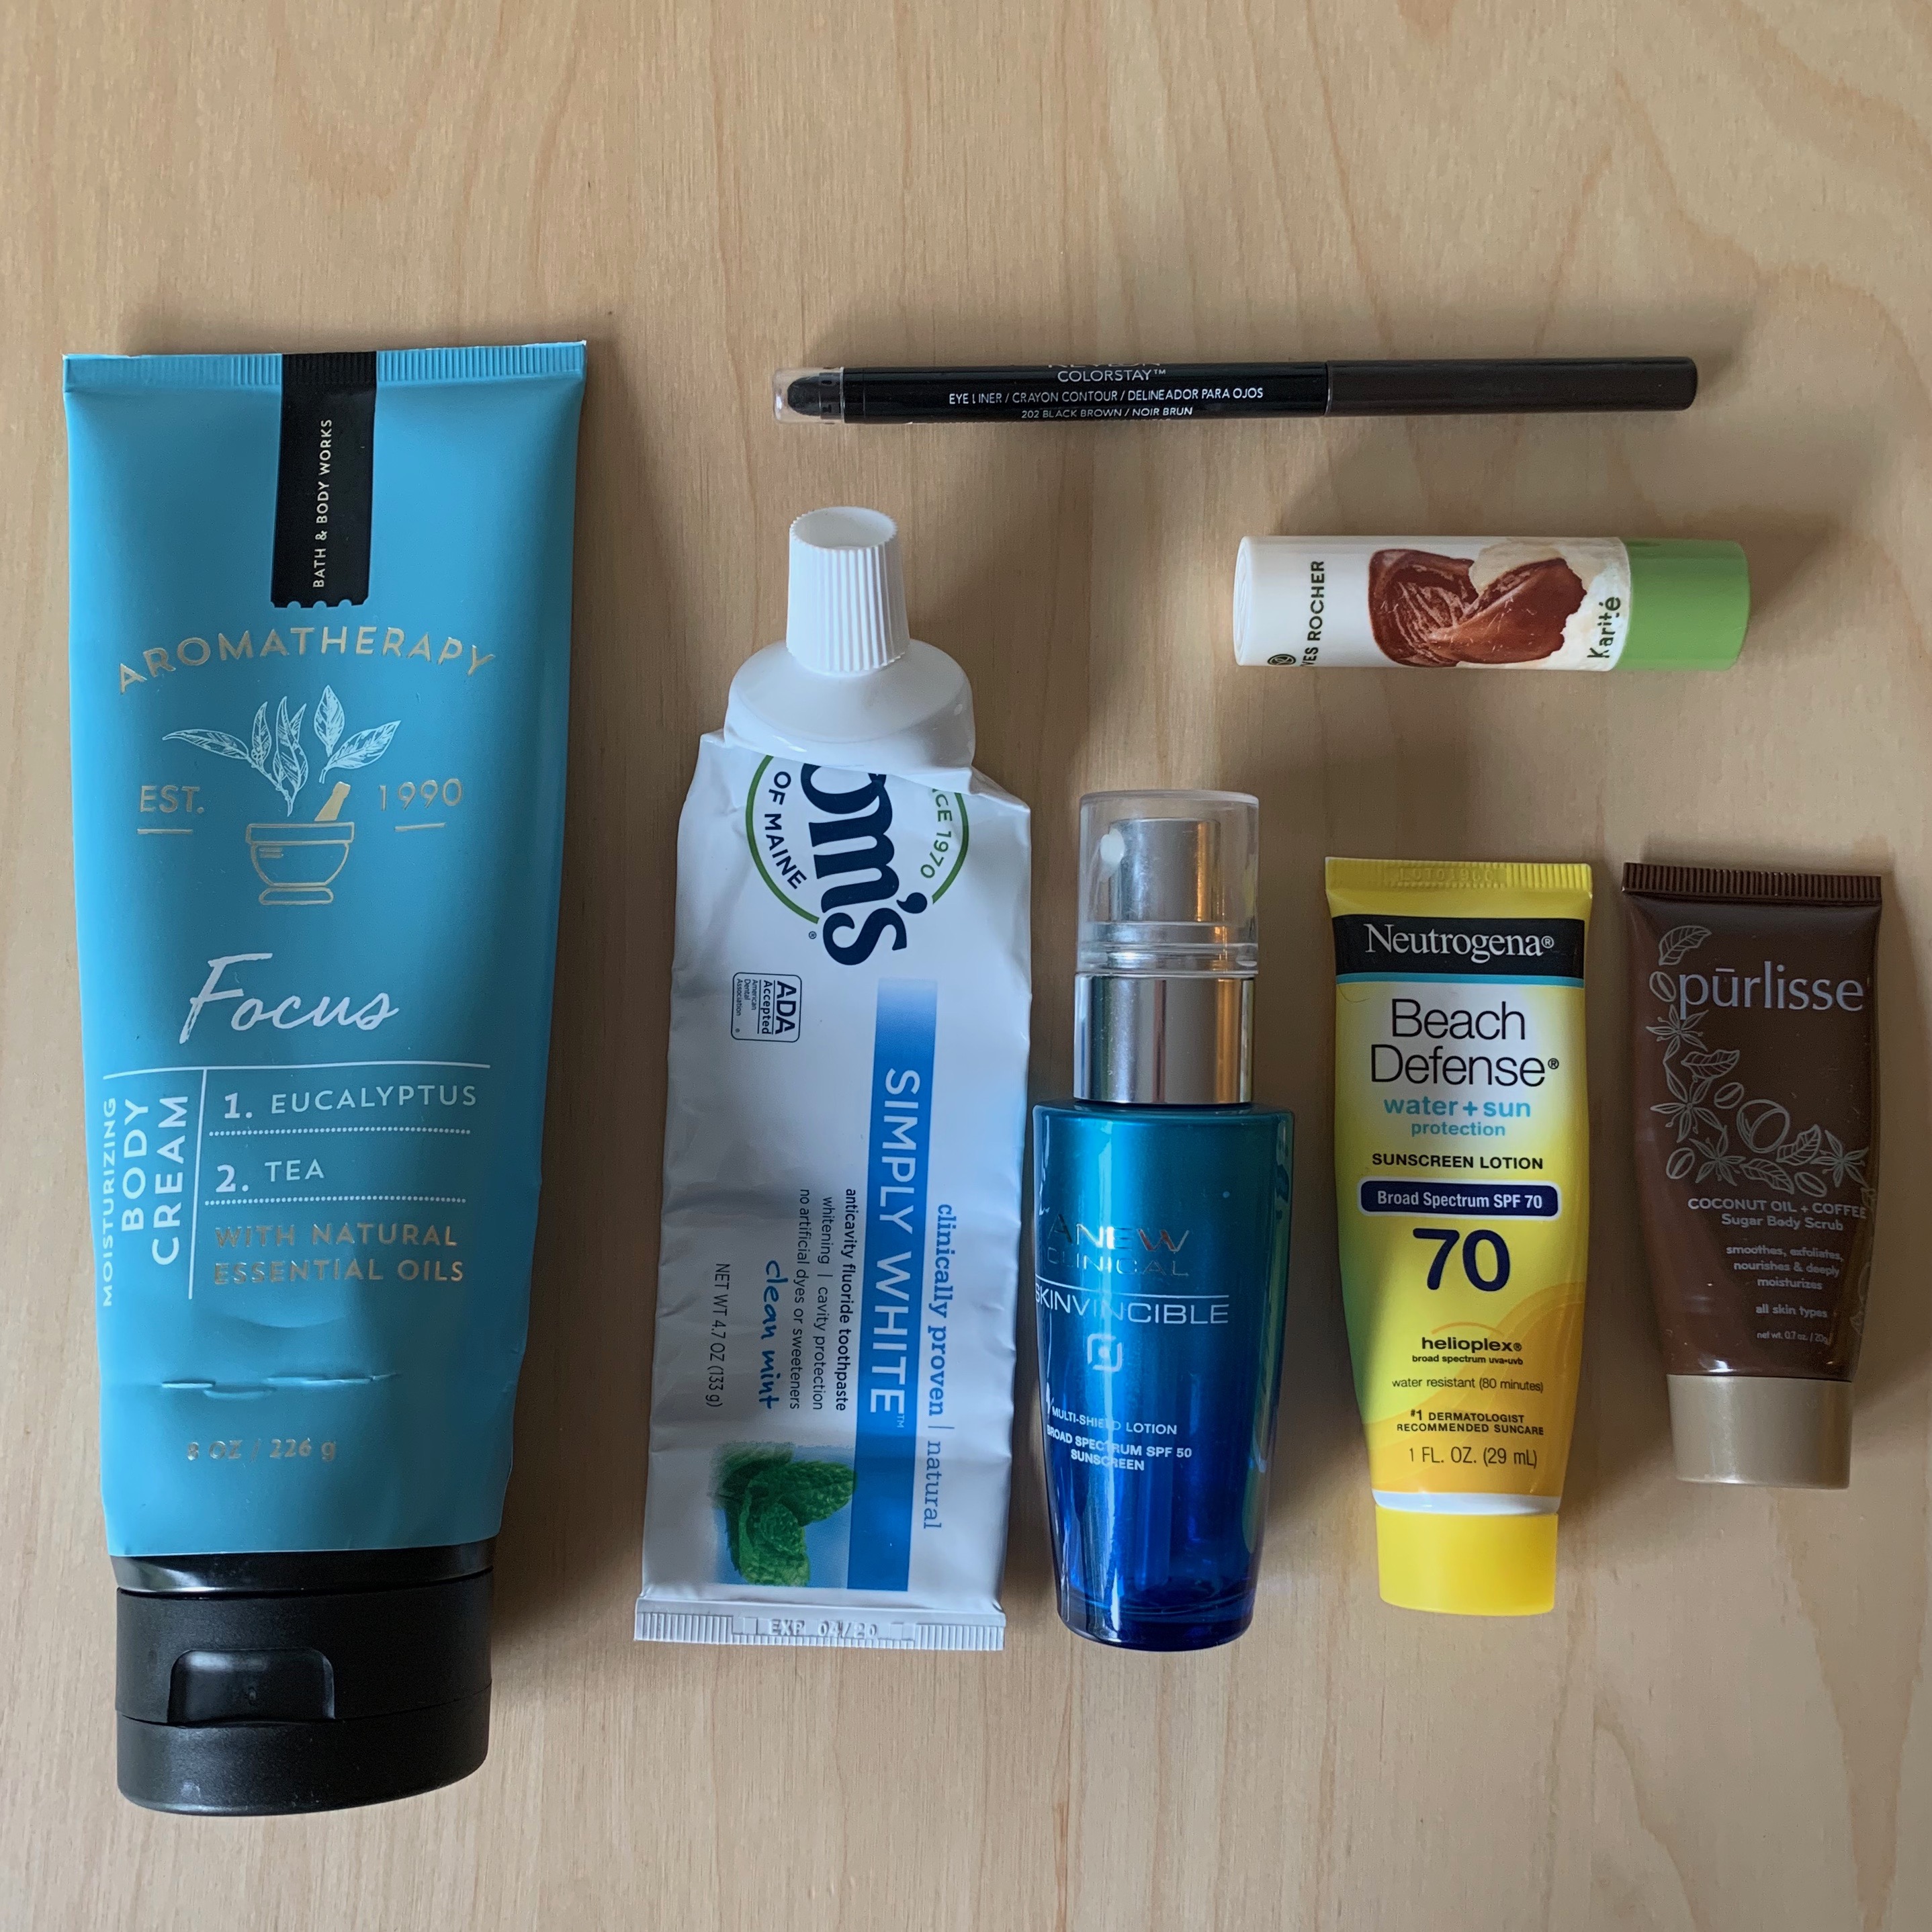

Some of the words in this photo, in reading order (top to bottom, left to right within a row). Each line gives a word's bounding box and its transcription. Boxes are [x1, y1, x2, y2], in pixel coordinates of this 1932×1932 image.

[949, 393, 969, 404] EYE
[972, 392, 1002, 404] LINER
[1012, 392, 1059, 403] CRAYON
[1062, 390, 1118, 402] CONTOUR
[1128, 388, 1198, 401] DELINEADOR
[1201, 388, 1230, 400] PARA
[1233, 388, 1264, 399] OJOS
[1021, 410, 1040, 419] 202
[1043, 409, 1078, 419] BLACK
[1080, 408, 1122, 417] BROWN
[1132, 408, 1159, 416] NOIR
[1163, 406, 1193, 416] BRUN
[318, 419, 333, 475] WORKS
[316, 480, 330, 524] BODY
[316, 527, 328, 541] &
[312, 549, 326, 588] BATH
[1307, 561, 1325, 641] ROCHER
[120, 627, 496, 694] AROMATHERAPY
[140, 785, 204, 814] EST.
[380, 778, 463, 811] 1990
[769, 771, 791, 806] OF
[932, 789, 953, 822] CE
[764, 814, 807, 889] MAINE
[920, 831, 952, 879] 1970
[179, 953, 399, 1044] Focus
[760, 980, 773, 1035] Accepted
[775, 981, 797, 1035] ADA
[1392, 998, 1525, 1041] Beach
[224, 1092, 253, 1120] 1.
[271, 1085, 477, 1115] EUCALYPTUS
[1384, 1096, 1458, 1116] water
[1483, 1101, 1531, 1117] sun
[1411, 1121, 1505, 1137] protection
[122, 1098, 148, 1231] BODY
[879, 1069, 920, 1235] SIMPLY
[1372, 1153, 1474, 1168] SUNSCREEN
[1480, 1155, 1543, 1170] LOTION
[152, 1096, 188, 1265] CREAM
[216, 1164, 249, 1194] 2.
[265, 1159, 325, 1182] TEA
[103, 1098, 116, 1307] MOISTURIZING
[799, 1188, 809, 1204] no
[1377, 1190, 1419, 1206] Broad
[1423, 1192, 1489, 1209] Spectrum
[1493, 1194, 1521, 1209] SPF
[1524, 1195, 1542, 1209] 70
[1687, 1198, 1767, 1211] COCONUT
[1771, 1201, 1797, 1213] OIL
[1812, 1202, 1867, 1219] COFFEE
[215, 1225, 296, 1248] WITH
[312, 1223, 458, 1247] NATURAL
[797, 1207, 811, 1264] artificial
[818, 1196, 835, 1264] whitening
[841, 1188, 858, 1258] anticavity
[1047, 1213, 1190, 1252] ANEW
[1722, 1213, 1763, 1227] Sugar
[1767, 1215, 1800, 1230] Body
[1804, 1217, 1843, 1231] Scrub
[214, 1260, 383, 1284] ESSENTIAL
[398, 1259, 464, 1282] OILS
[715, 1264, 730, 1290] NET
[929, 1202, 956, 1319] clinically
[1047, 1247, 1189, 1276] CLINICAL
[1413, 1228, 1511, 1292] 70
[1734, 1260, 1790, 1272] nourishes
[1806, 1264, 1839, 1277] deeply
[760, 1260, 788, 1340] clean
[793, 1270, 809, 1303] dyes
[840, 1264, 856, 1323] fluoride
[1757, 1276, 1823, 1290] moisturizes
[713, 1294, 728, 1316] WT
[793, 1309, 804, 1325] or
[814, 1286, 830, 1331] cavity
[1035, 1282, 1229, 1324] SKINVINCIBLE
[1755, 1304, 1768, 1314] all
[1772, 1305, 1796, 1315] skin
[1799, 1306, 1828, 1318] types
[711, 1319, 726, 1339] 4.7
[709, 1344, 725, 1361] OZ
[790, 1329, 803, 1409] sweeteners
[834, 1329, 851, 1411] toothpaste
[928, 1325, 949, 1415] proven
[1412, 1355, 1440, 1363] broad
[1442, 1356, 1487, 1365] spectrum
[707, 1366, 723, 1391] (133
[758, 1350, 780, 1409] mint
[812, 1335, 827, 1410] protection
[1392, 1378, 1421, 1388] water
[1427, 1376, 1475, 1388] resistant
[1479, 1377, 1497, 1391] (80
[1500, 1379, 1544, 1393] minutes)
[1126, 1422, 1177, 1435] LOTION
[1397, 1423, 1489, 1432] RECOMMENDED
[1494, 1424, 1544, 1436] SUNCARE
[1411, 1409, 1422, 1421] #1
[1429, 1412, 1524, 1423] DERMATOLOGIST
[187, 1442, 200, 1461] 8
[208, 1440, 243, 1460] OZ
[269, 1438, 312, 1459] 226
[320, 1442, 336, 1462] g
[1047, 1424, 1073, 1444] BROAD
[1146, 1446, 1172, 1458] SPF
[1176, 1448, 1192, 1458] 50
[1409, 1448, 1414, 1462] 1
[1422, 1447, 1444, 1463] FL.
[1451, 1446, 1477, 1464] OZ.
[1483, 1447, 1507, 1467] (29
[1513, 1449, 1538, 1469] mL)
[1071, 1449, 1145, 1471] SUNSCREEN
[924, 1442, 943, 1530] natural
[769, 1619, 805, 1636] EXP
